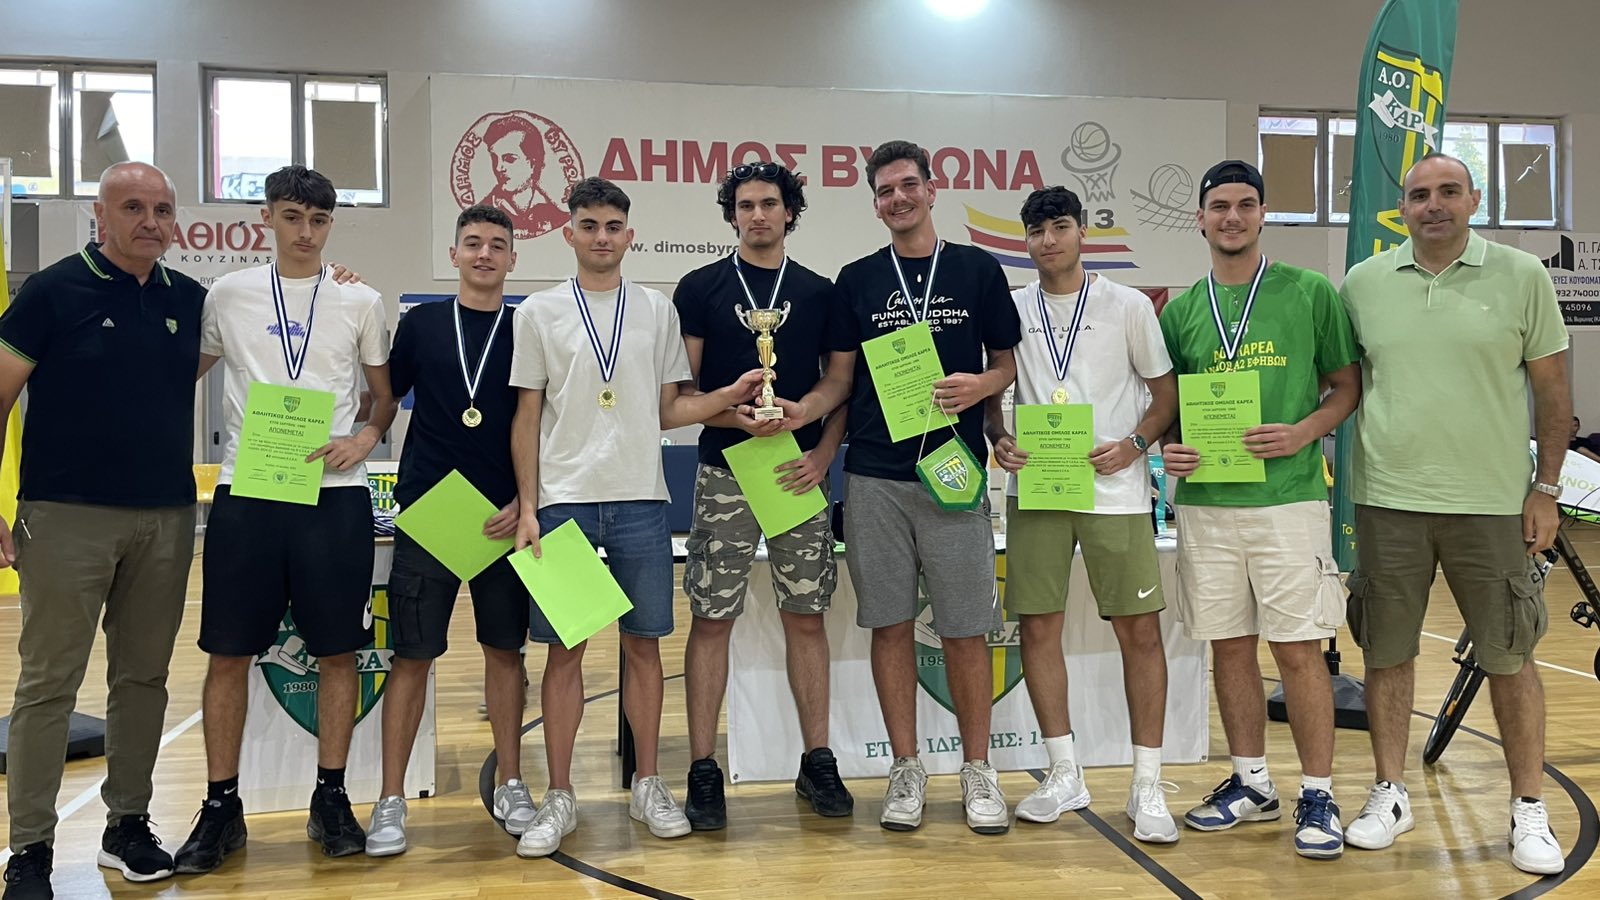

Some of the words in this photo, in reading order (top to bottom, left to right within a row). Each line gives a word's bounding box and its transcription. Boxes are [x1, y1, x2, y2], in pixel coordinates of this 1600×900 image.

[1386, 98, 1424, 128] ΚΑΡ
[1378, 131, 1400, 143] 1980
[456, 132, 482, 204] ΔΗΜΟΣ
[599, 138, 807, 187] ΔΗΜΟΣ
[822, 145, 1044, 191] ΒΩΝΑ
[181, 255, 272, 264] ΚΟΥΖΙΝΑΣ
[886, 290, 954, 311] Calioria
[1565, 303, 1592, 311] 45096
[878, 319, 940, 329] ESTABLED
[1247, 355, 1287, 367] ΕΦΗΒΩΝ
[919, 655, 946, 667] 198
[283, 681, 317, 693] 1980
[927, 731, 1023, 754] ΙΔΡΗΣ:
